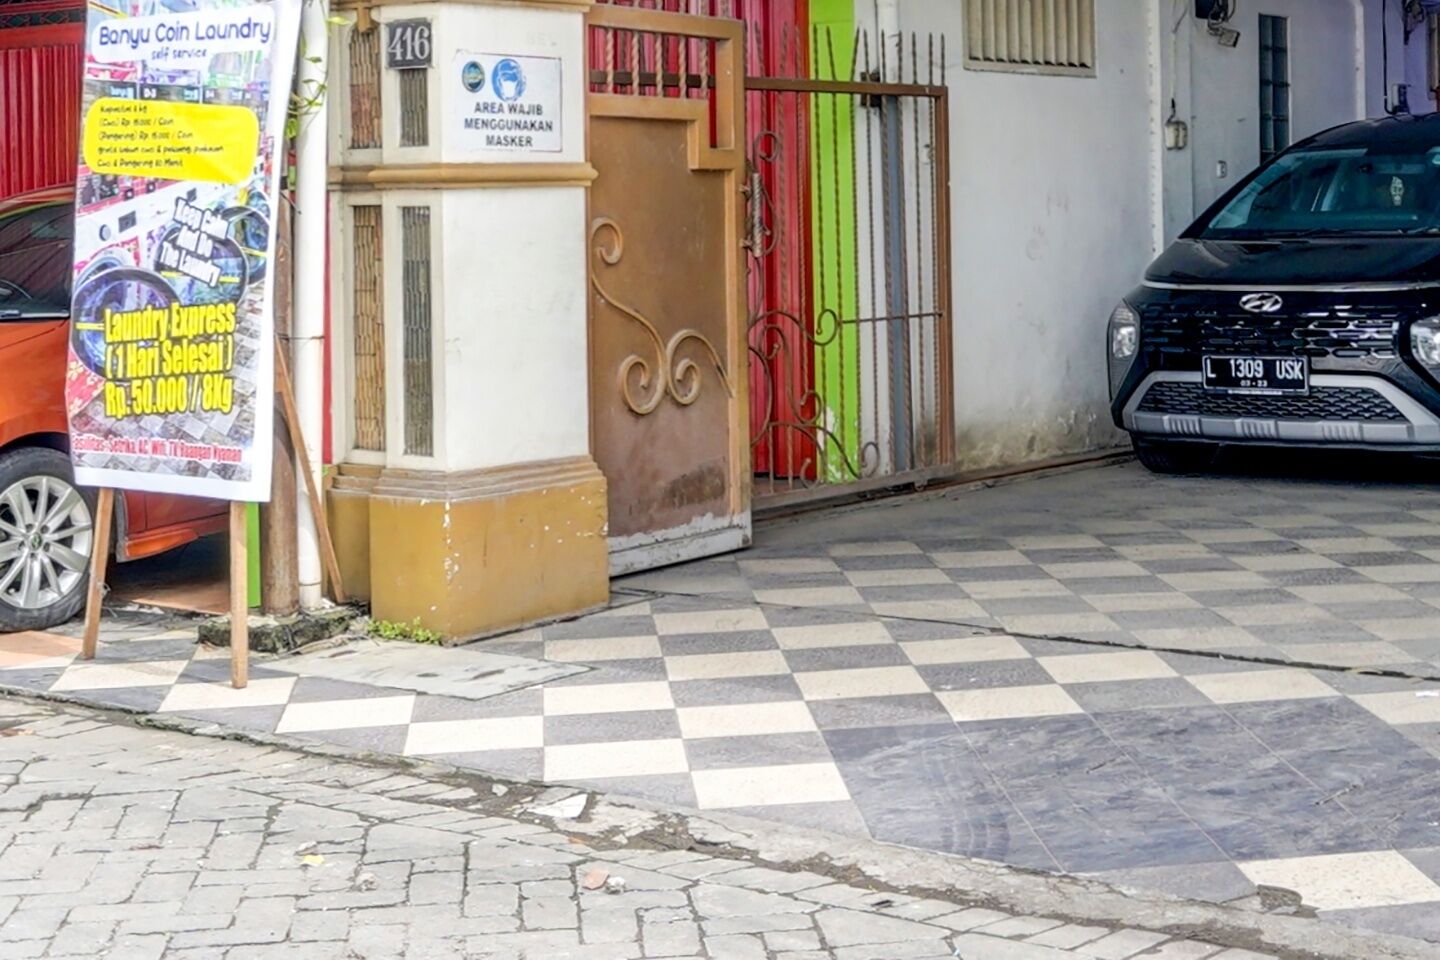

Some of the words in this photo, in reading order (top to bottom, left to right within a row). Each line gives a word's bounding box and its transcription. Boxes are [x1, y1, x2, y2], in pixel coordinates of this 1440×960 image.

[99, 26, 150, 49] Banyu
[155, 20, 190, 43] Coin
[195, 17, 271, 43] Laundry
[387, 25, 431, 61] 416
[152, 47, 168, 61] self
[173, 48, 207, 58] service
[474, 101, 505, 115] AREA
[508, 103, 543, 116] WAJIB
[464, 117, 553, 132] MENGGUNAKAN
[485, 135, 533, 148] MASKER
[160, 240, 180, 269] The
[104, 304, 169, 344] Laundry
[170, 302, 237, 340] Express
[126, 340, 160, 378] Hari
[162, 335, 224, 375] Selesai
[1206, 358, 1217, 378] L
[1229, 358, 1264, 378] 1309
[1275, 359, 1303, 380] USK
[105, 380, 131, 420] Rp.
[131, 376, 188, 415] 50.000
[189, 373, 200, 413] /
[201, 372, 233, 414] 8Kg
